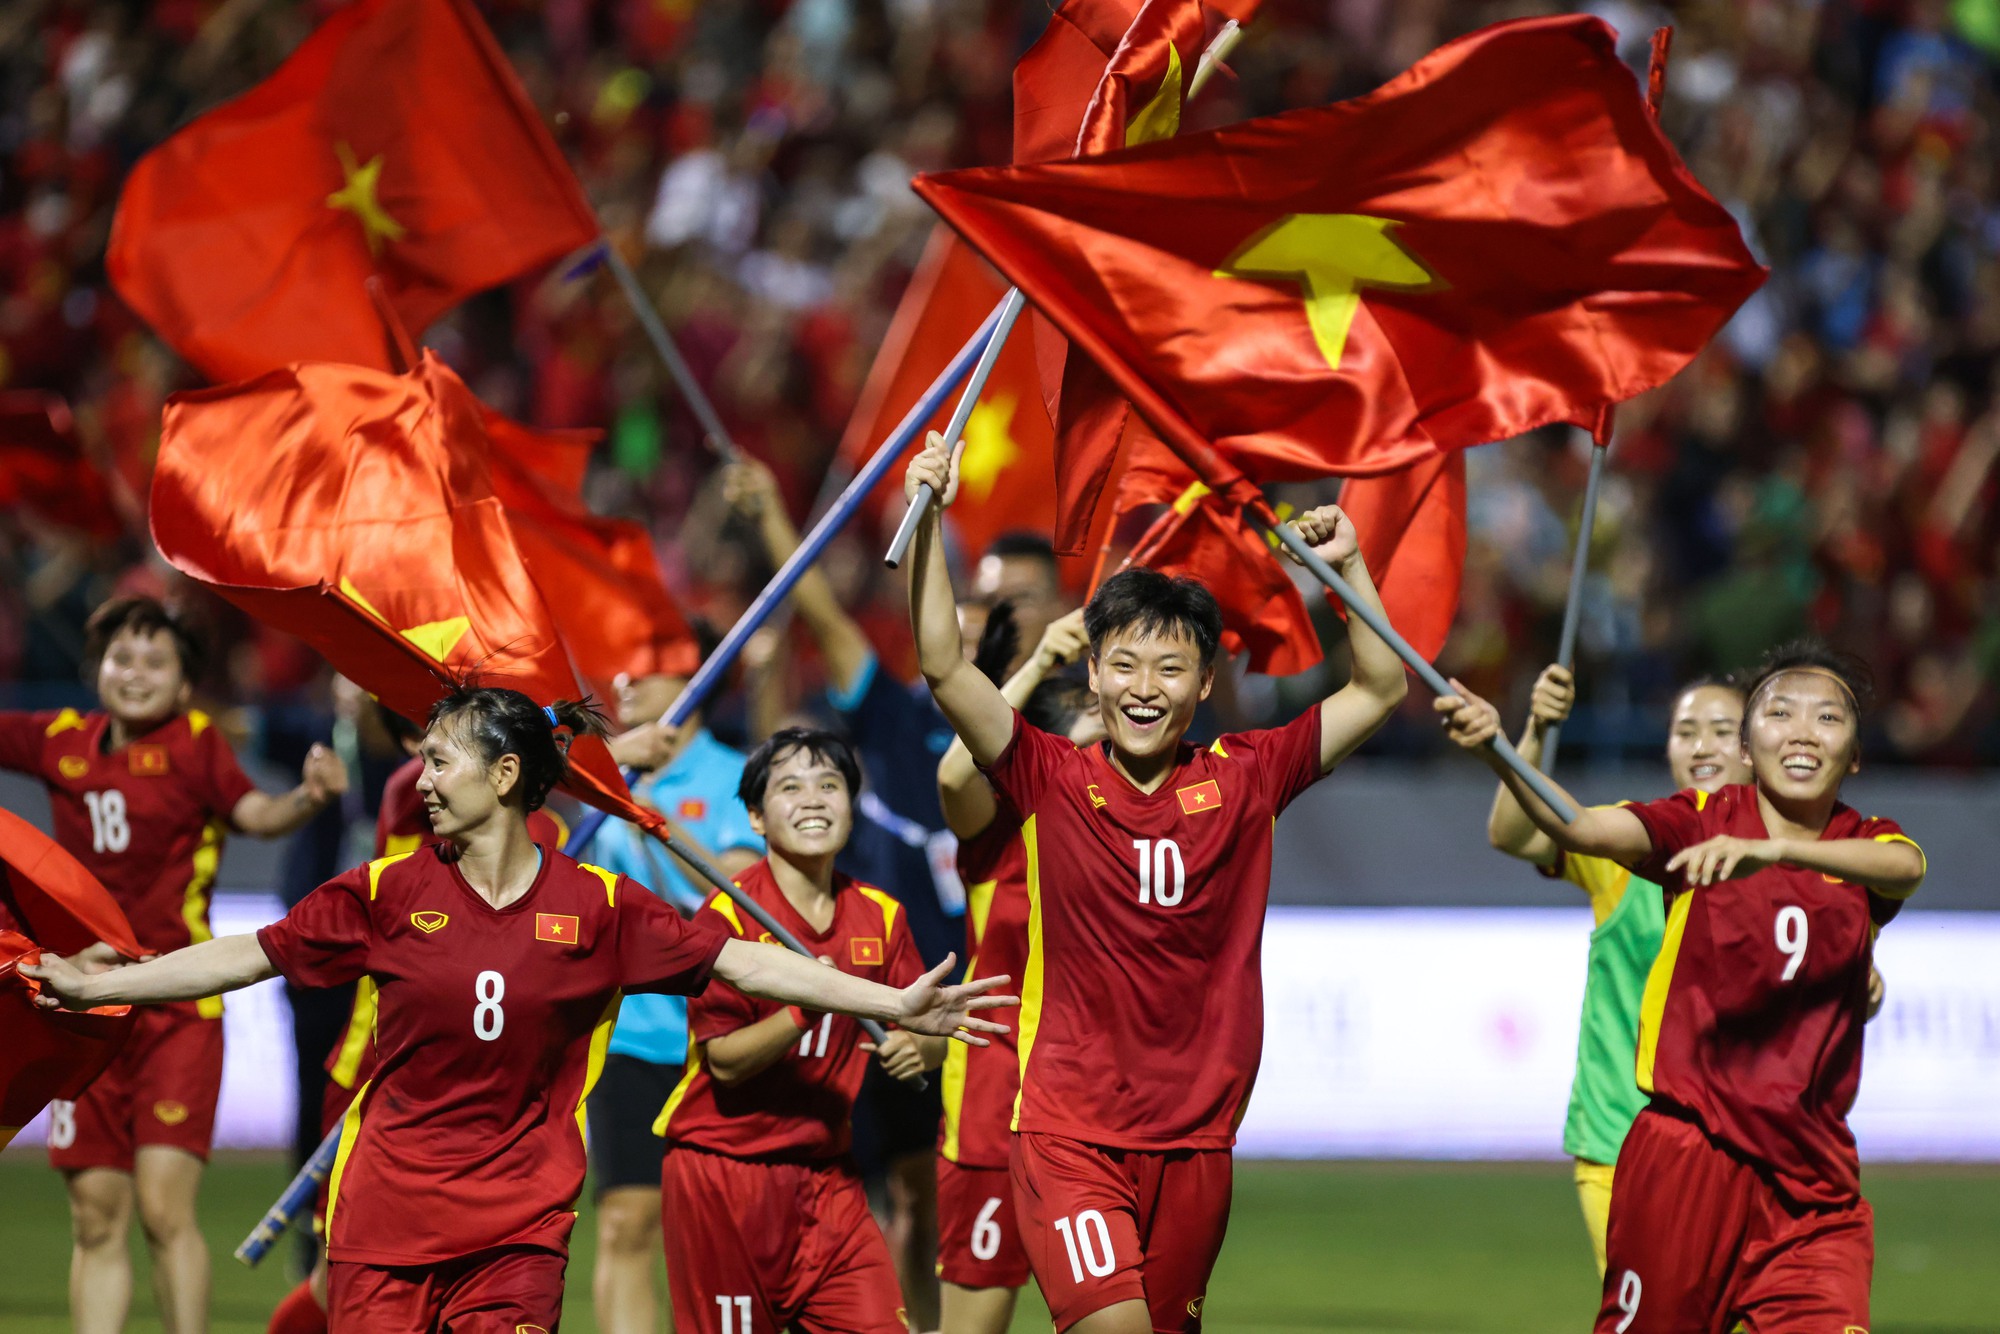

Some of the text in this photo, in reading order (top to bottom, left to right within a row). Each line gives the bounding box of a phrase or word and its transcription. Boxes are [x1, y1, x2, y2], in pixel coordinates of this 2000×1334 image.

[84, 789, 131, 853] 18
[1132, 837, 1186, 907] 10
[1773, 905, 1809, 982] 9
[473, 969, 506, 1042] 8
[970, 1197, 1002, 1261] 6
[1053, 1208, 1116, 1285] 10
[715, 1294, 752, 1334] 11
[1615, 1269, 1643, 1334] 9
